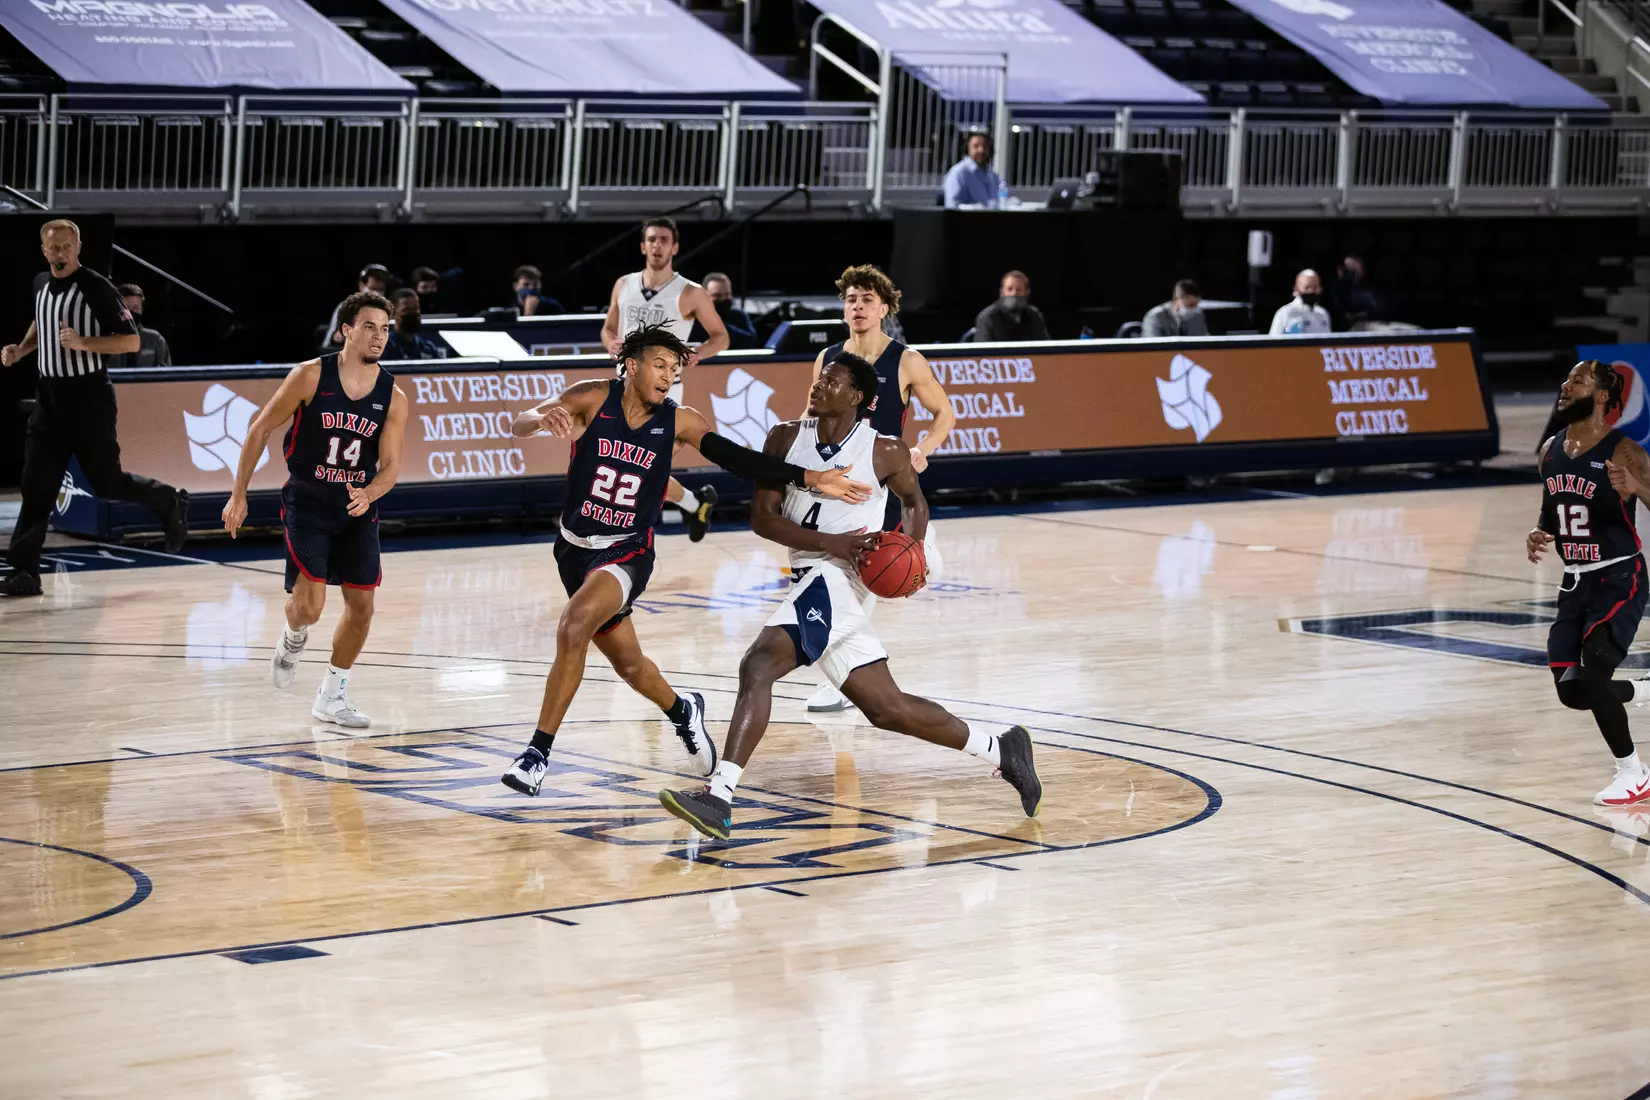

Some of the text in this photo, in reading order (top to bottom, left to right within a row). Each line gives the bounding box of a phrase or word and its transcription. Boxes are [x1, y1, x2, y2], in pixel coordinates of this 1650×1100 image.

[929, 358, 1036, 385] VERSIDE
[1320, 345, 1437, 372] RIVERSIDE
[412, 374, 567, 403] RIVERSIDE
[1327, 376, 1428, 404] MEDICAL
[910, 392, 1025, 421] MDICAL
[321, 412, 378, 438] DIXIE
[420, 412, 552, 441] MEDIC
[1335, 409, 1409, 436] CLINIC
[326, 436, 362, 467] 14
[428, 448, 525, 479] CLINIC
[598, 438, 657, 469] DIXIE
[315, 465, 366, 482] STATE
[590, 464, 642, 508] 22
[1546, 474, 1597, 500] DIXIE
[581, 500, 636, 528] STATE
[801, 502, 822, 532] 4
[1556, 504, 1590, 537] 12
[1562, 543, 1601, 560] TATE
